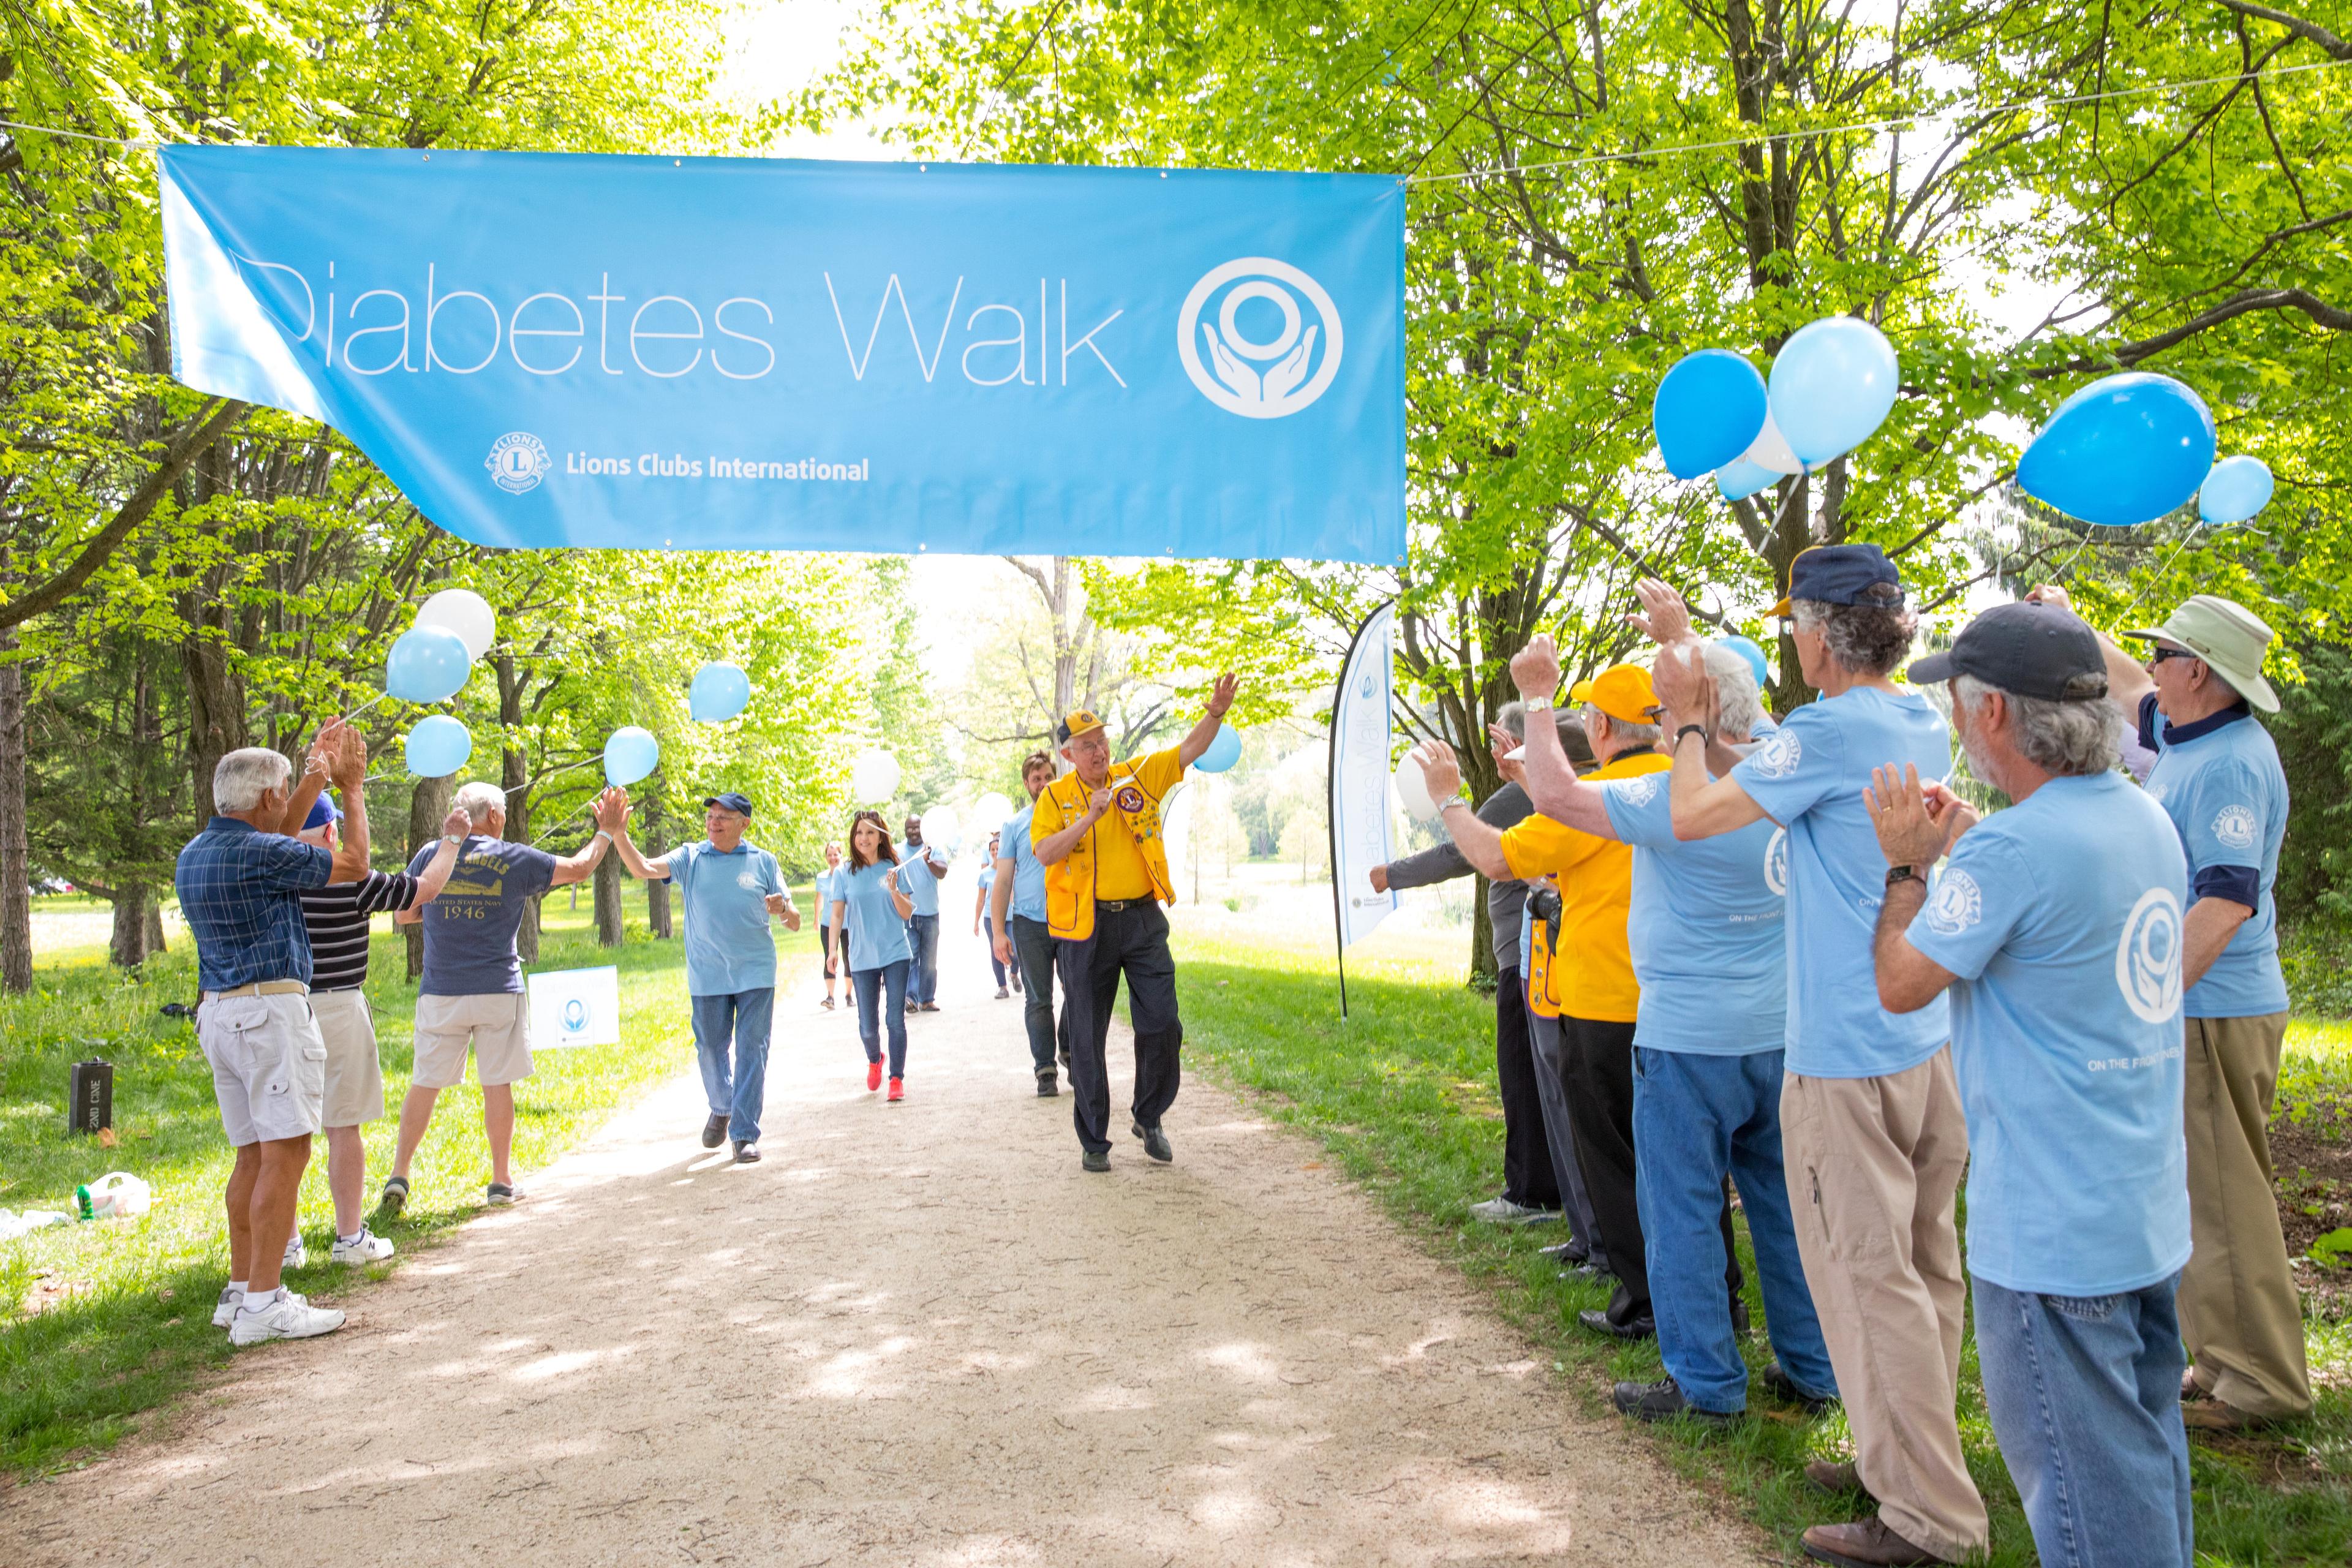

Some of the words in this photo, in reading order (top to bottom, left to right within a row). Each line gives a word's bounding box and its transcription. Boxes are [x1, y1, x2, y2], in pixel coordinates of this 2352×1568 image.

[228, 247, 775, 379] Diabetes
[824, 271, 1128, 388] Walk
[499, 434, 538, 449] LIONS
[511, 451, 527, 472] L
[567, 451, 631, 475] Lions
[638, 453, 703, 478] Clubs
[709, 456, 869, 481] International
[1355, 707, 1380, 769] Walk
[1766, 742, 1782, 763] L
[2223, 805, 2252, 820] LIONS
[2232, 818, 2244, 834] L
[464, 851, 510, 876] ANGELS
[443, 906, 485, 919] 1946
[1858, 898, 1874, 907] ON
[1942, 888, 1956, 916] L
[2087, 1060, 2106, 1071] ON
[2108, 1058, 2129, 1069] THE
[89, 1107, 99, 1128] 2ND
[368, 1240, 375, 1250] N
